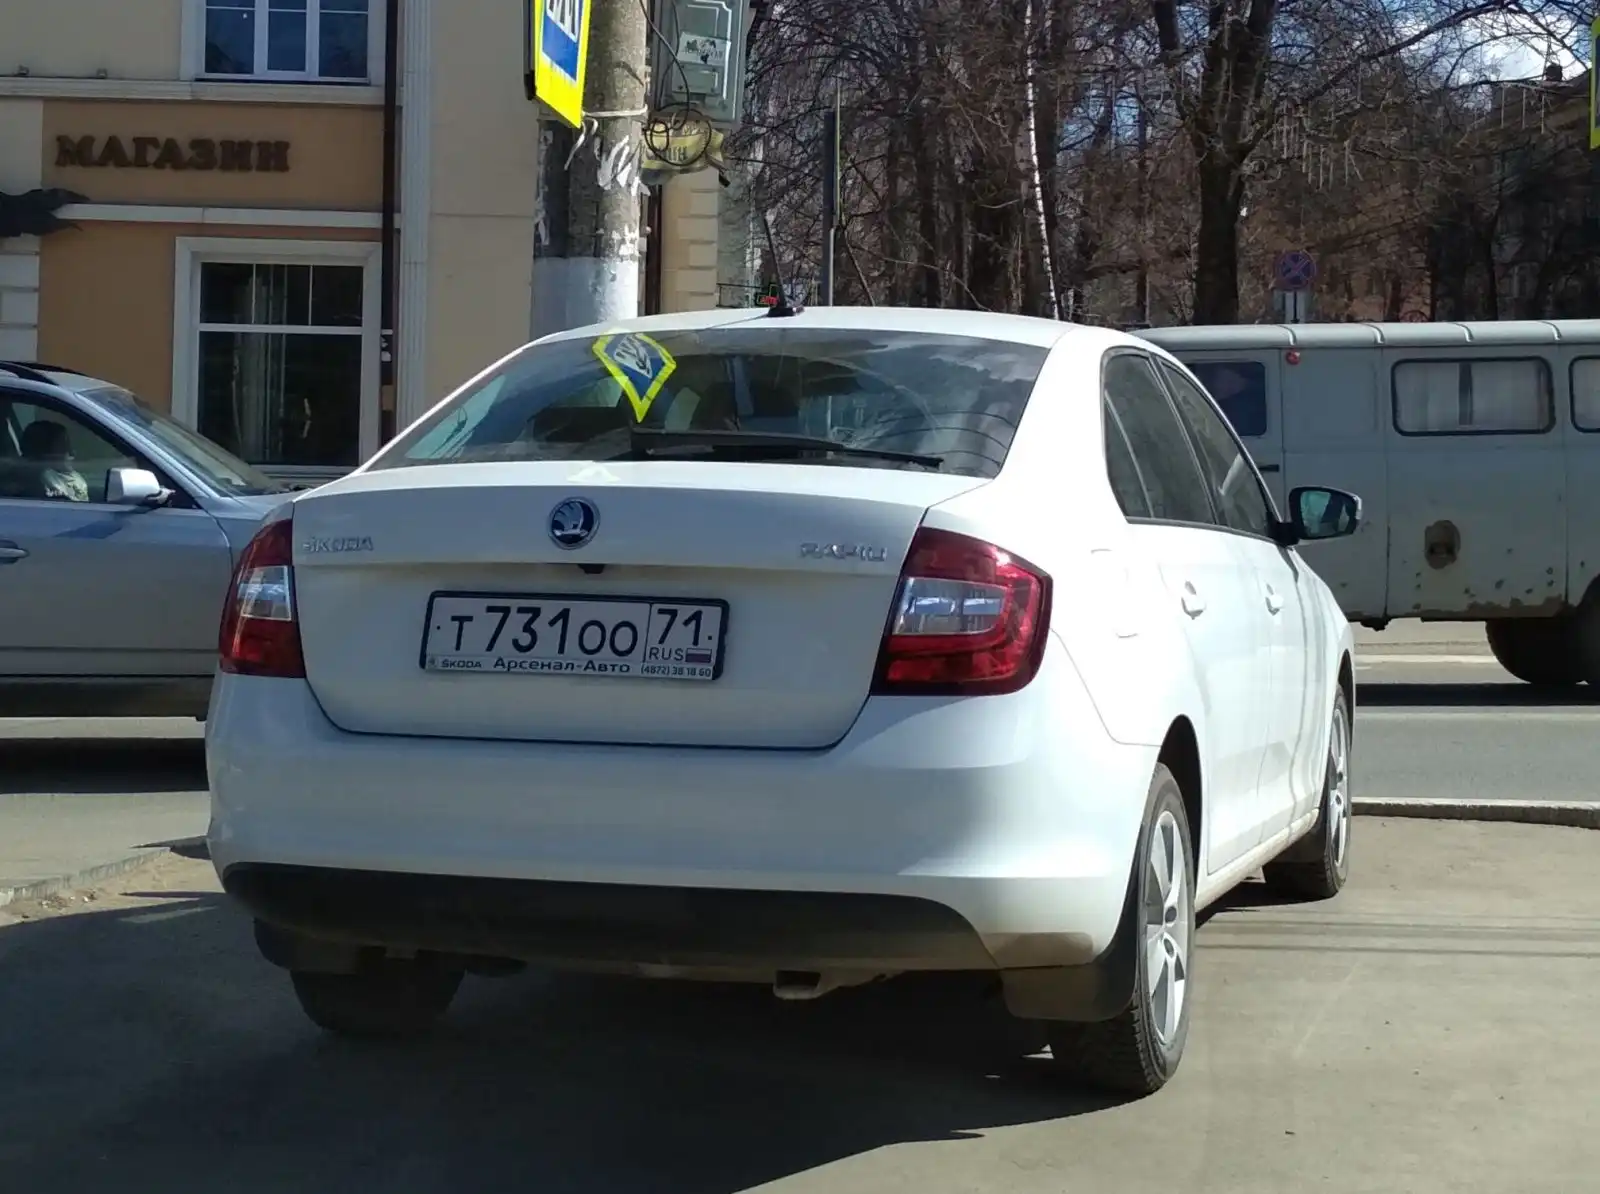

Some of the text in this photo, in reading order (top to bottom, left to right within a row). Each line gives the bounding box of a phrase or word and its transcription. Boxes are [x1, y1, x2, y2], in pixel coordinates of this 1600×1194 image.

[55, 135, 290, 172] МАГАЗИН
[657, 608, 703, 646] 71
[493, 656, 631, 673] Арсенал-Авто
[649, 647, 684, 661] RUS
